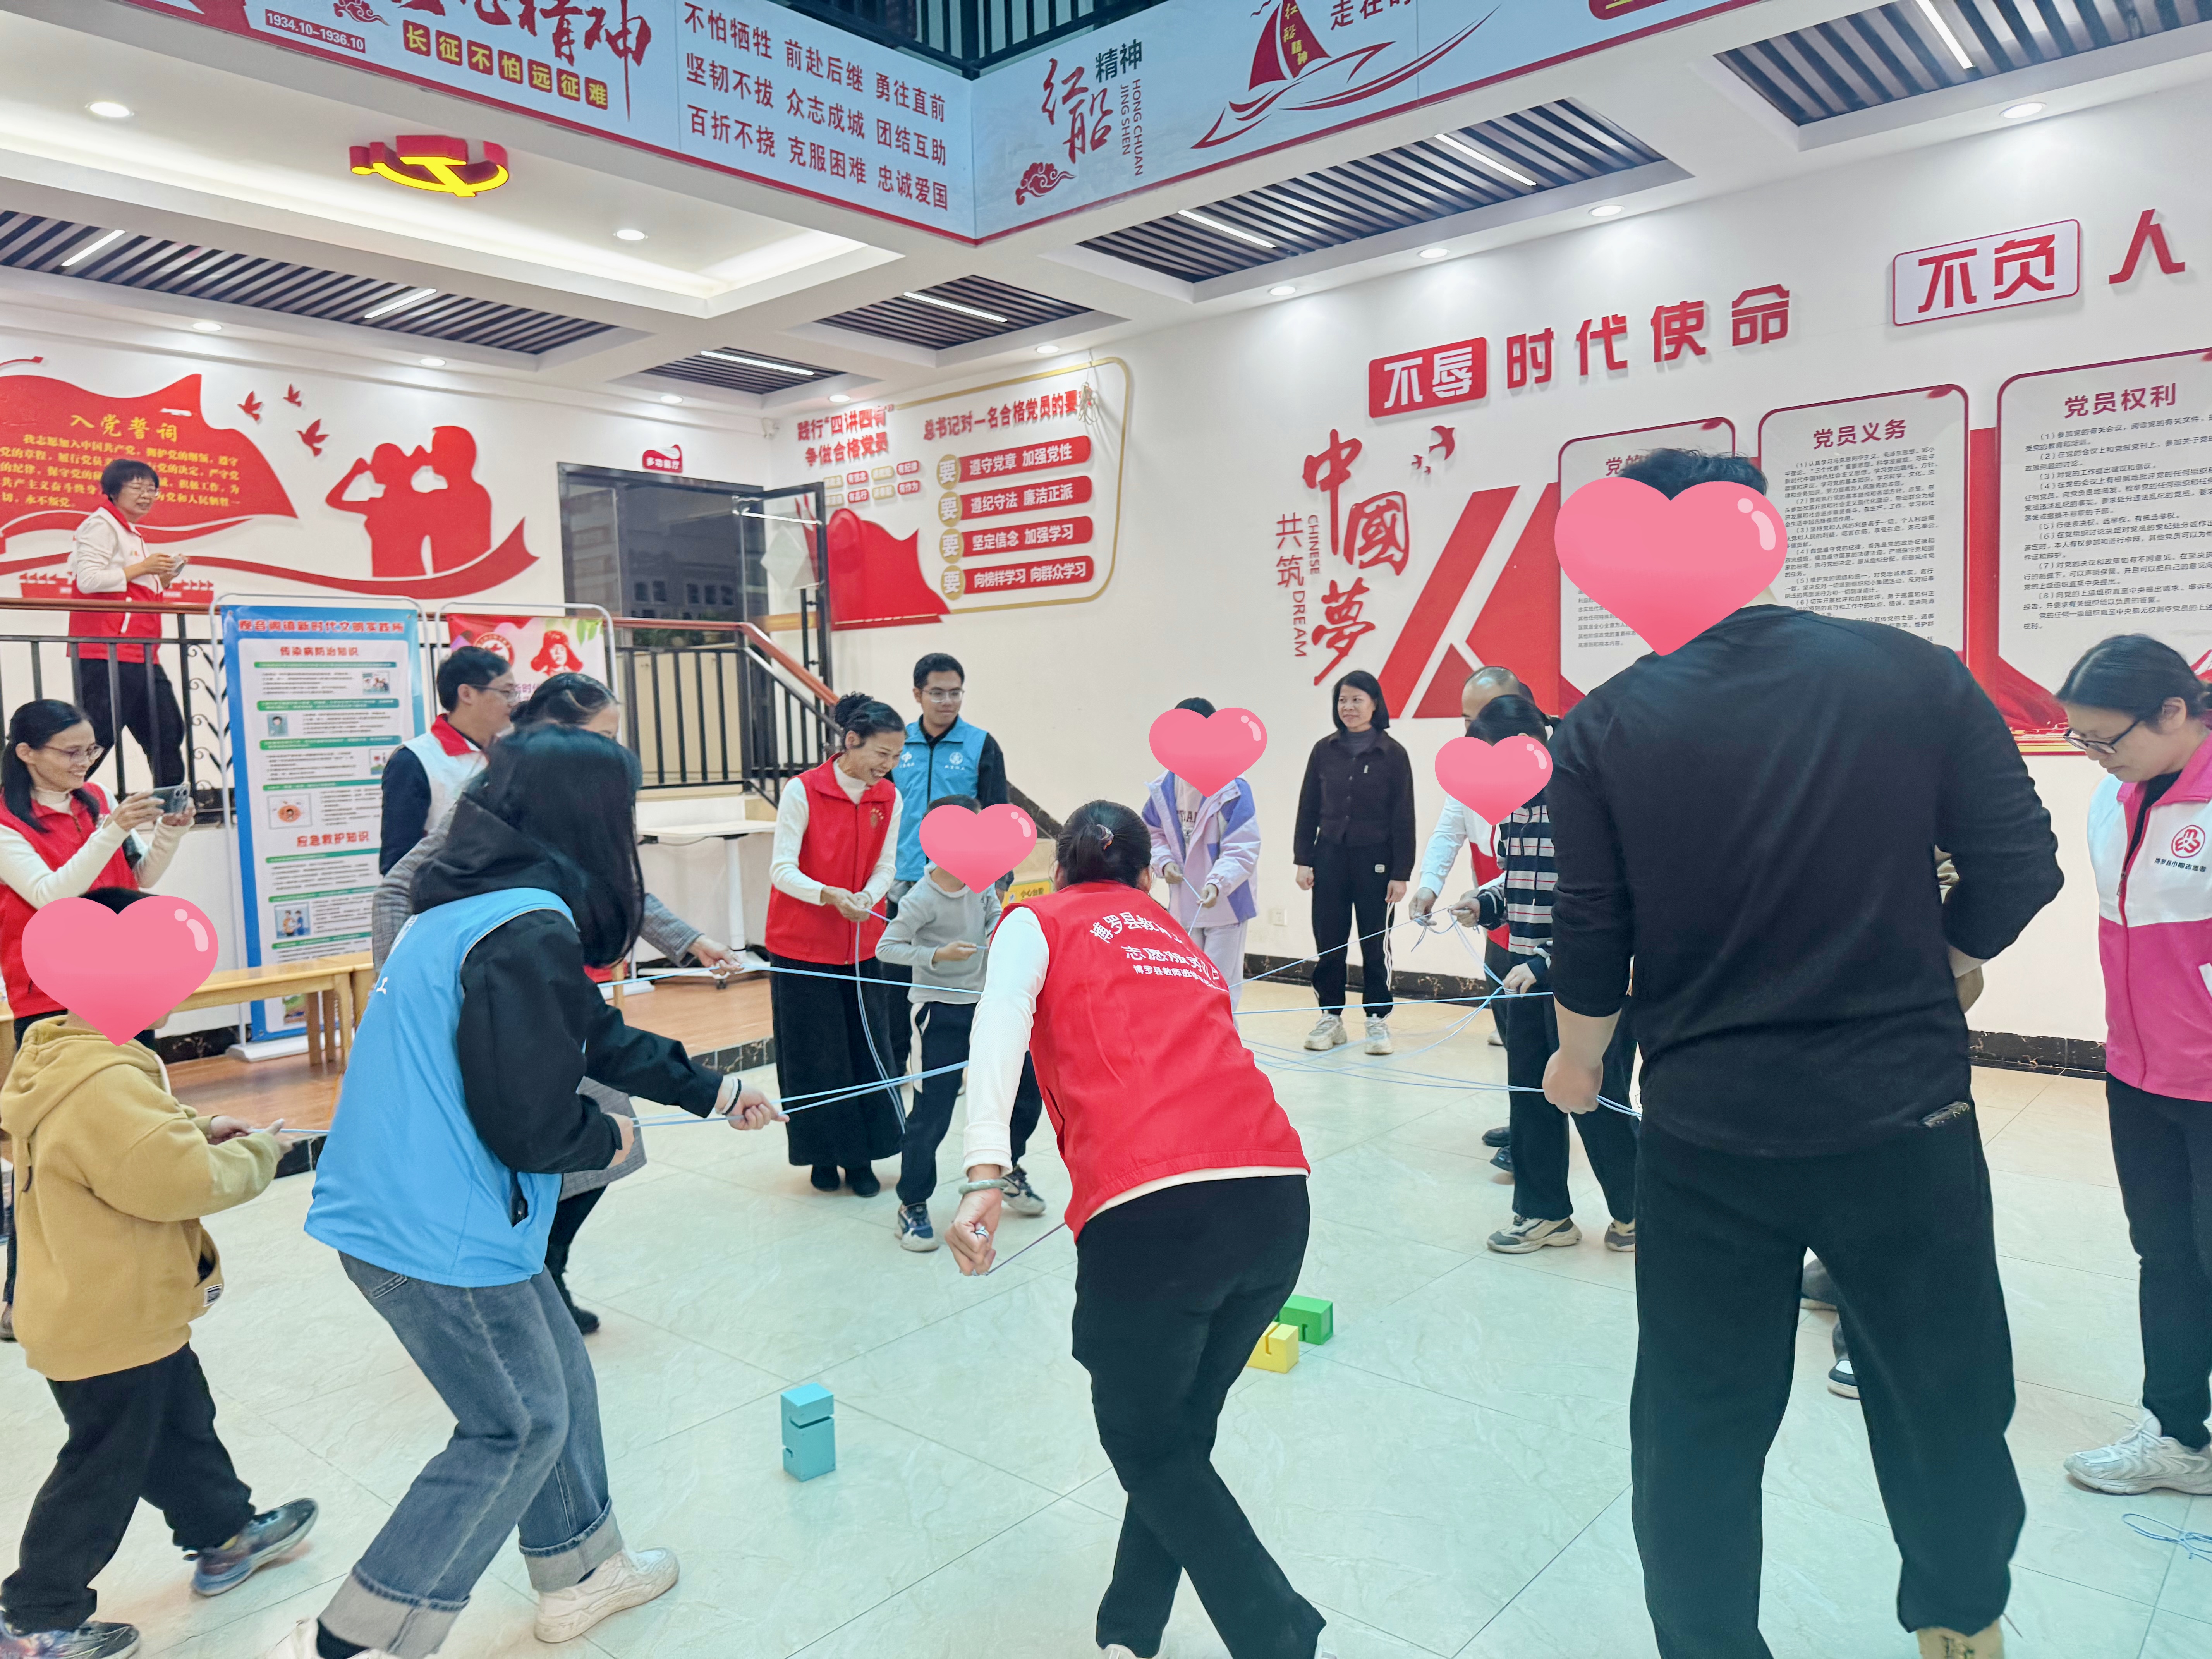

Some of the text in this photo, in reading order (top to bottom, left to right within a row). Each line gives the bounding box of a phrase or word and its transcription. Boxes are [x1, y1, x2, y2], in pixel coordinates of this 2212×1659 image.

[267, 13, 363, 50] 1934.10-1936.10
[1331, 0, 1411, 30] 走在
[407, 25, 607, 105] 长征不怕远征难
[685, 2, 945, 122] 不怕牺牲 前赴后继 勇往直前
[1096, 39, 1142, 83] 精神
[686, 53, 946, 166] 坚韧不拔 众志成城 团结互助
[1042, 58, 1113, 164] 红船
[1121, 84, 1130, 155] JING SHEN
[1133, 79, 1143, 176] HONG CHUAN
[687, 104, 947, 211] 百折不挠 克服困难 忠诚爱国
[1918, 208, 2185, 313] 不负 人
[1384, 284, 1790, 409] 不辱 时代使命
[2064, 383, 2176, 418] 党员权利
[70, 414, 177, 442] 入党誓词
[805, 432, 888, 466] 争做合格党员
[1814, 419, 1906, 450] 党员义务
[939, 443, 1072, 484] 要 遵守党章 加强党性
[941, 484, 1073, 521] 要 遵纪守法 廉洁正派
[942, 524, 1073, 557] 要 坚定信念 加强学习
[1276, 512, 1305, 588] 共筑
[1308, 515, 1320, 575] CHINESE
[944, 562, 1085, 594] 要 向榜样学习 向群众学习
[1293, 590, 1307, 657] DREAM
[297, 831, 370, 847] 应急救护知识
